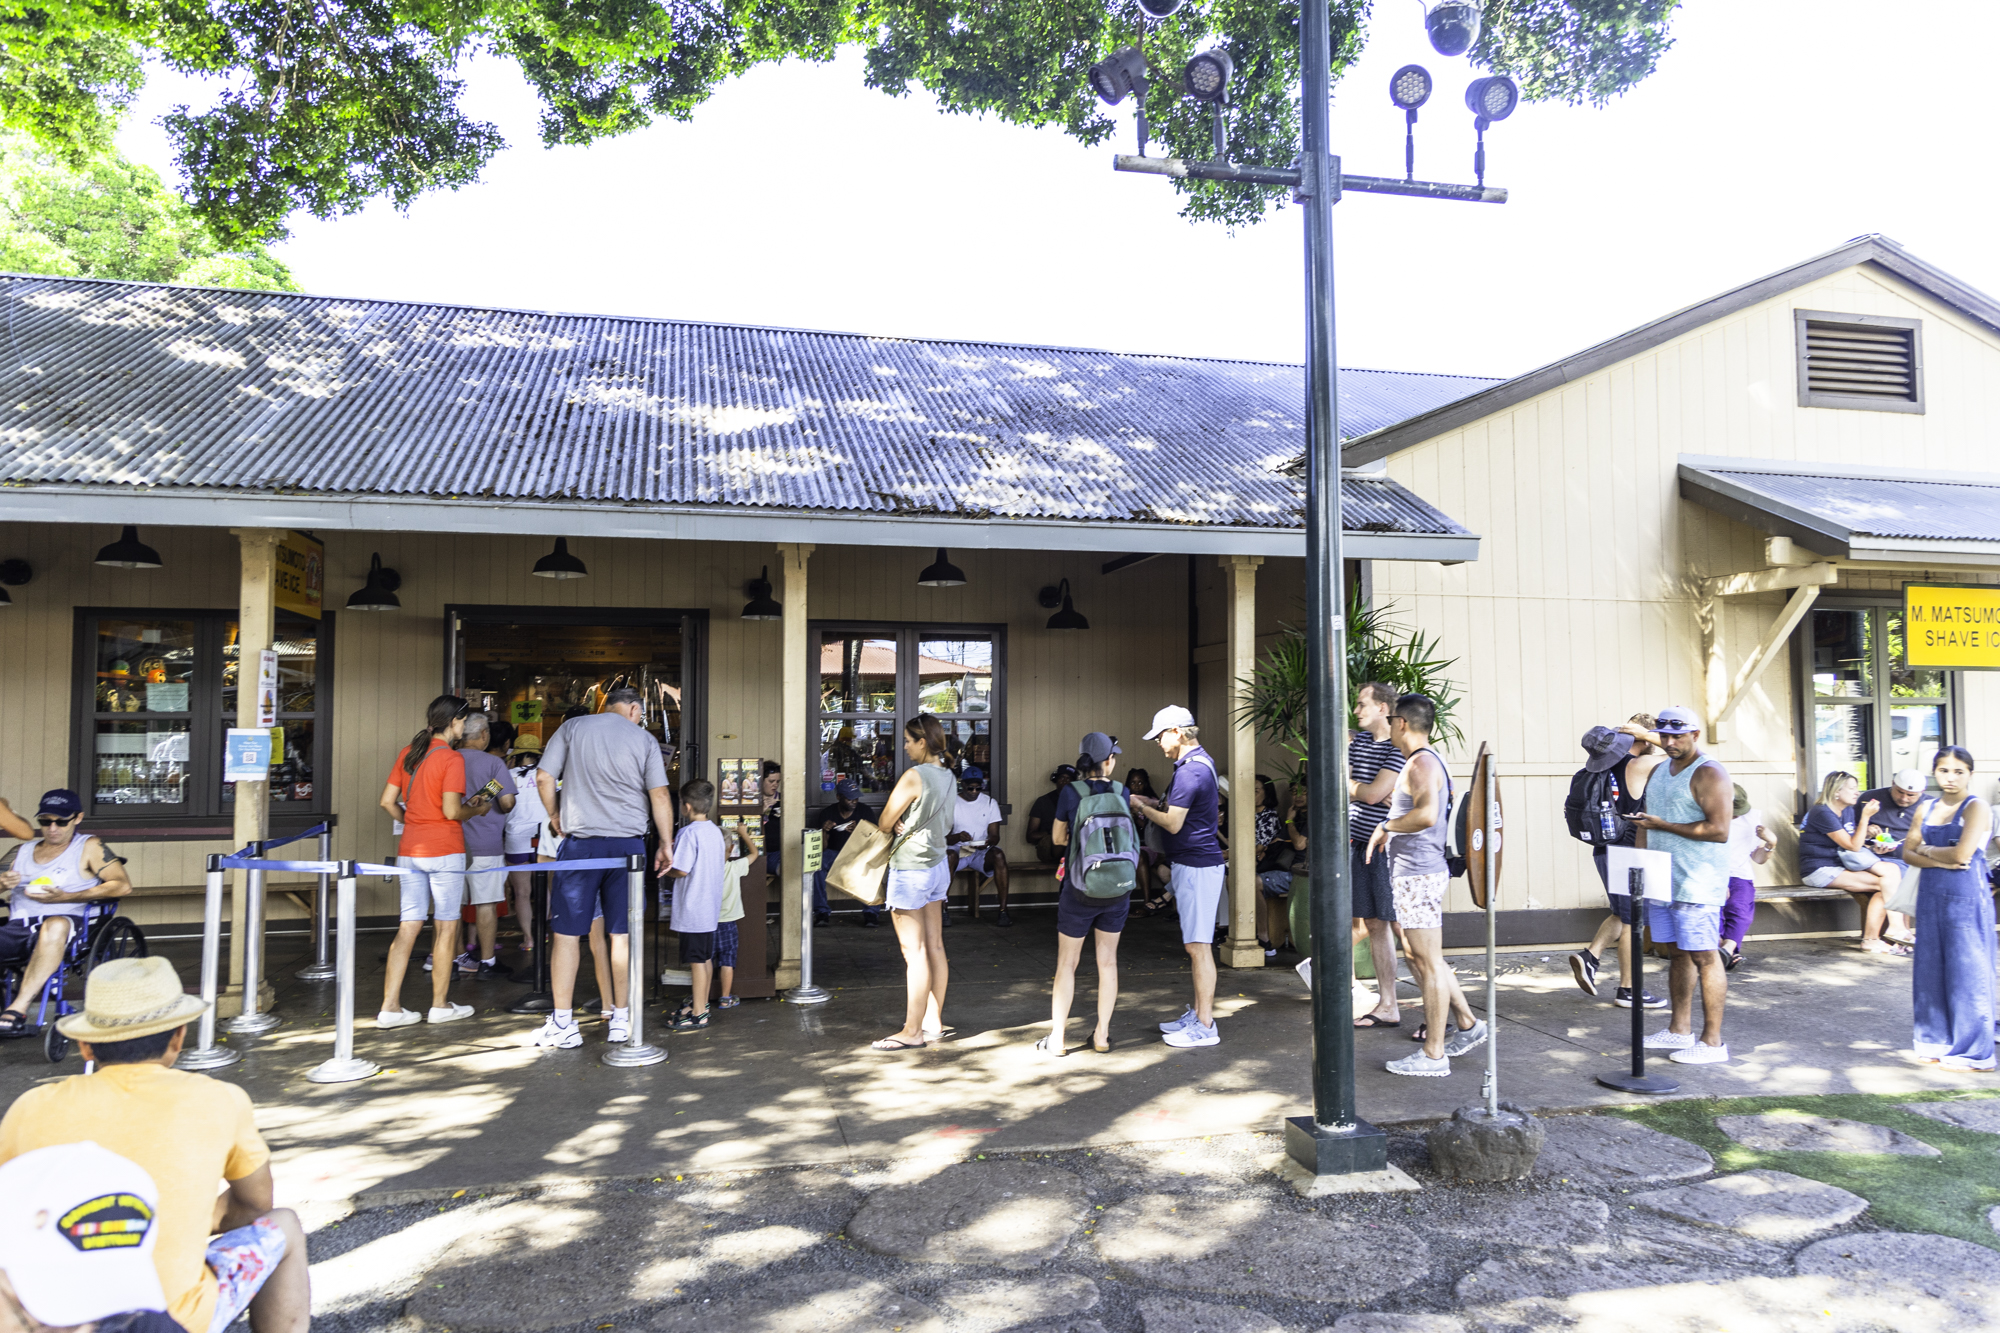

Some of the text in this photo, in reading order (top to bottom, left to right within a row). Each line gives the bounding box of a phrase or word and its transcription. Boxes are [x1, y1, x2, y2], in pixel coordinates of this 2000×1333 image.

[289, 574, 300, 594] ICE
[1911, 605, 1927, 622] M.
[1925, 629, 1979, 647] SHAVE
